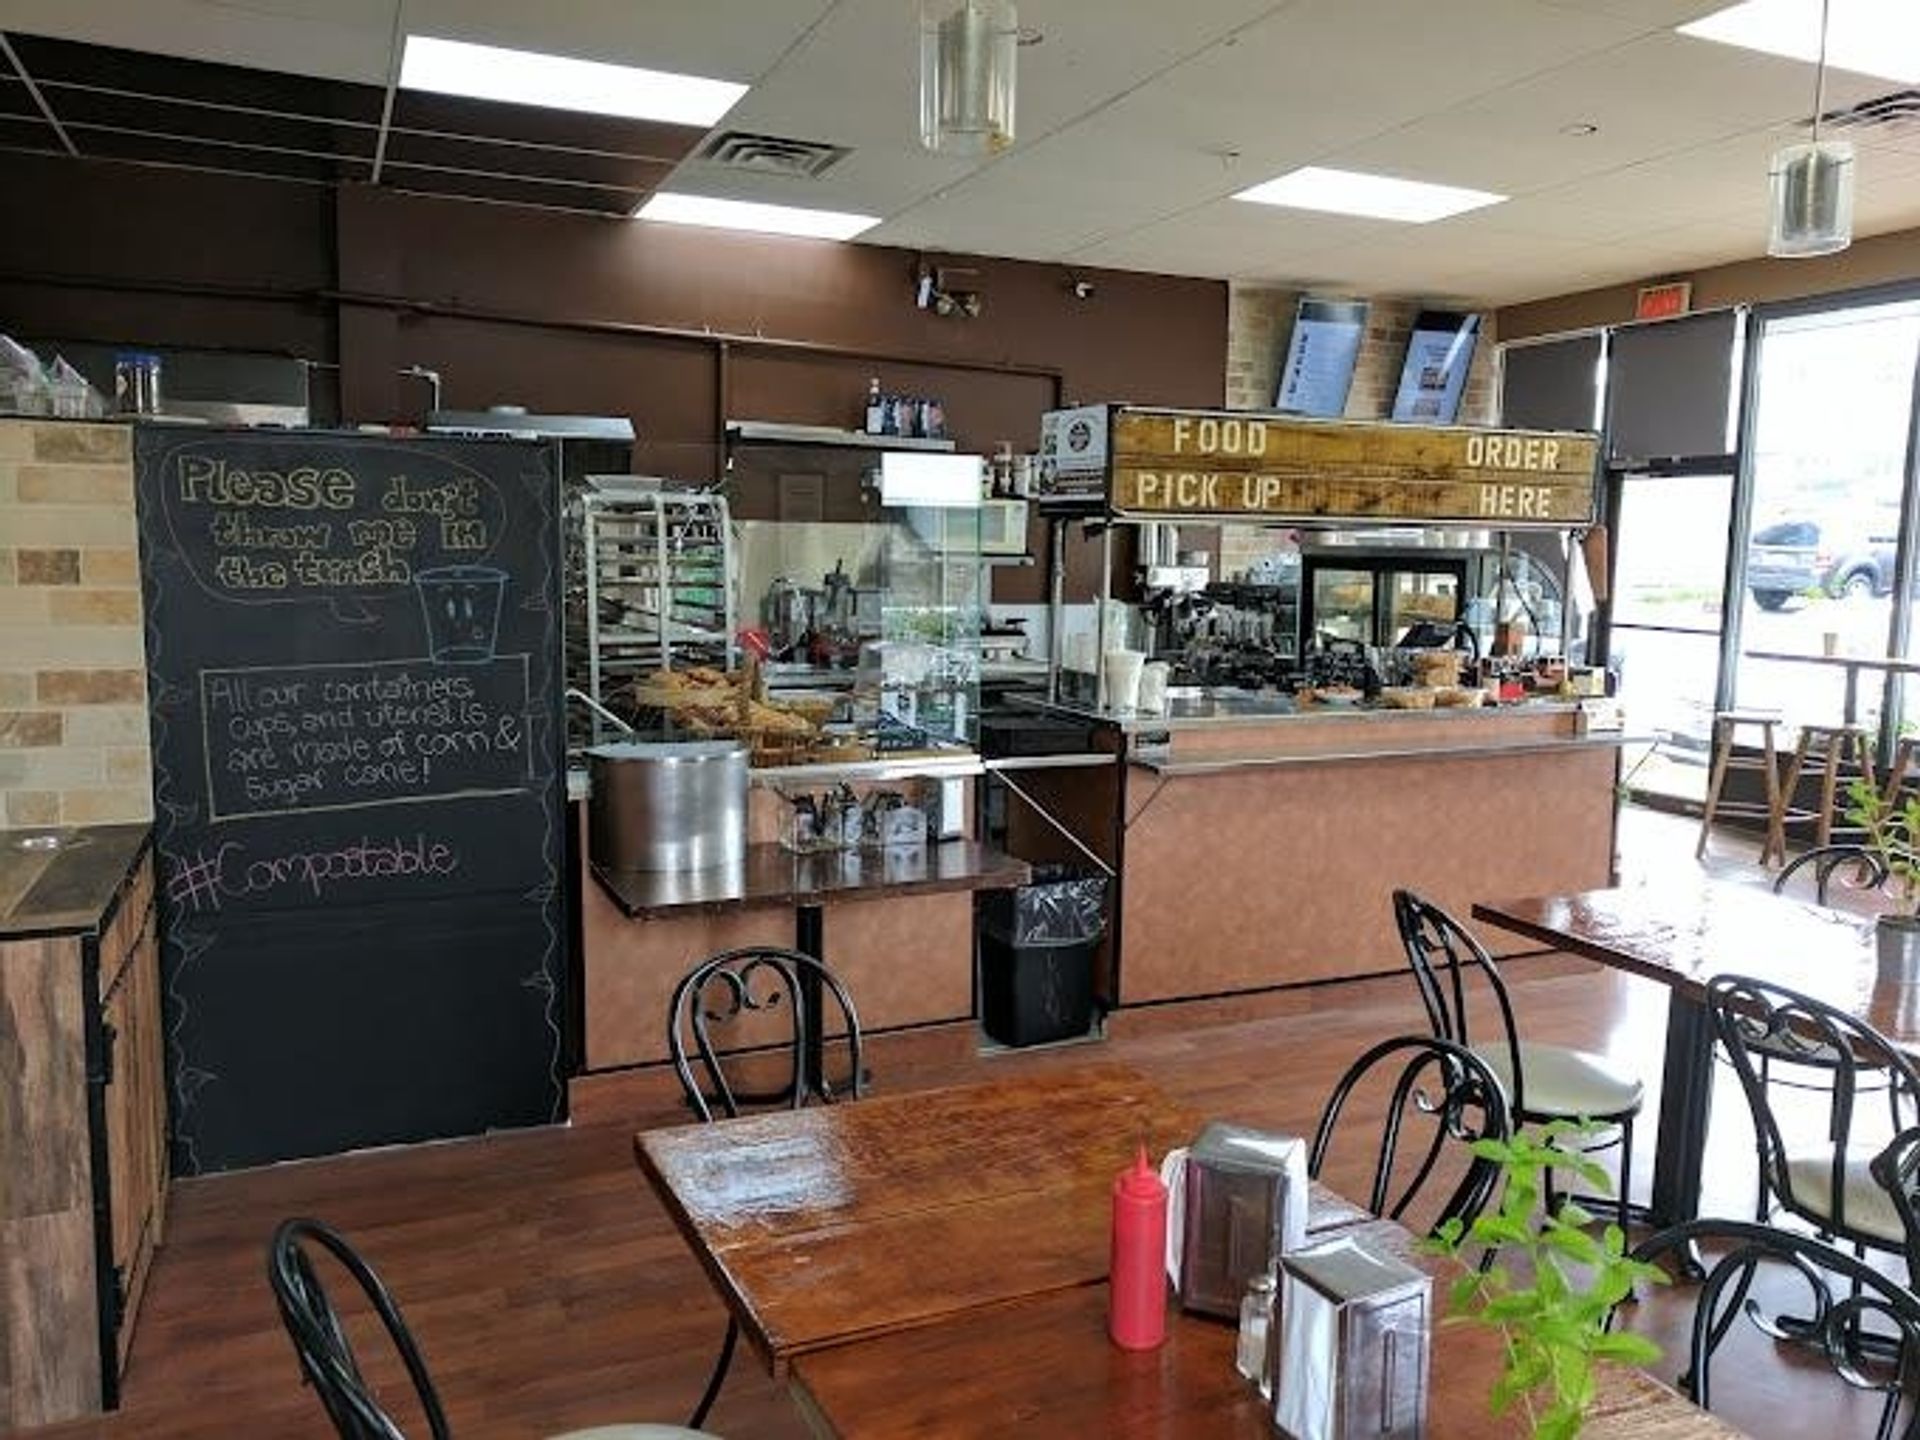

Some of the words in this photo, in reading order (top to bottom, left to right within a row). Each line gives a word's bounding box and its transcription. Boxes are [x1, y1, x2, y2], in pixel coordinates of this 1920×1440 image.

[1174, 419, 1267, 457] FOOD
[1466, 435, 1560, 470] ORDER
[178, 454, 356, 510] Please
[1137, 473, 1220, 509] PICK
[1243, 476, 1281, 510] UP
[1480, 484, 1551, 518] HERE
[211, 510, 333, 549] throw
[347, 515, 418, 550] me
[441, 518, 487, 550] in
[216, 555, 287, 588] the
[293, 549, 411, 586] trash
[211, 677, 252, 713] All
[258, 682, 303, 708] our
[302, 706, 354, 732] and
[365, 697, 489, 728] utensils
[226, 747, 281, 772] are
[294, 735, 371, 767] made
[377, 728, 407, 756] of
[414, 730, 490, 757] corn
[494, 713, 522, 752] &
